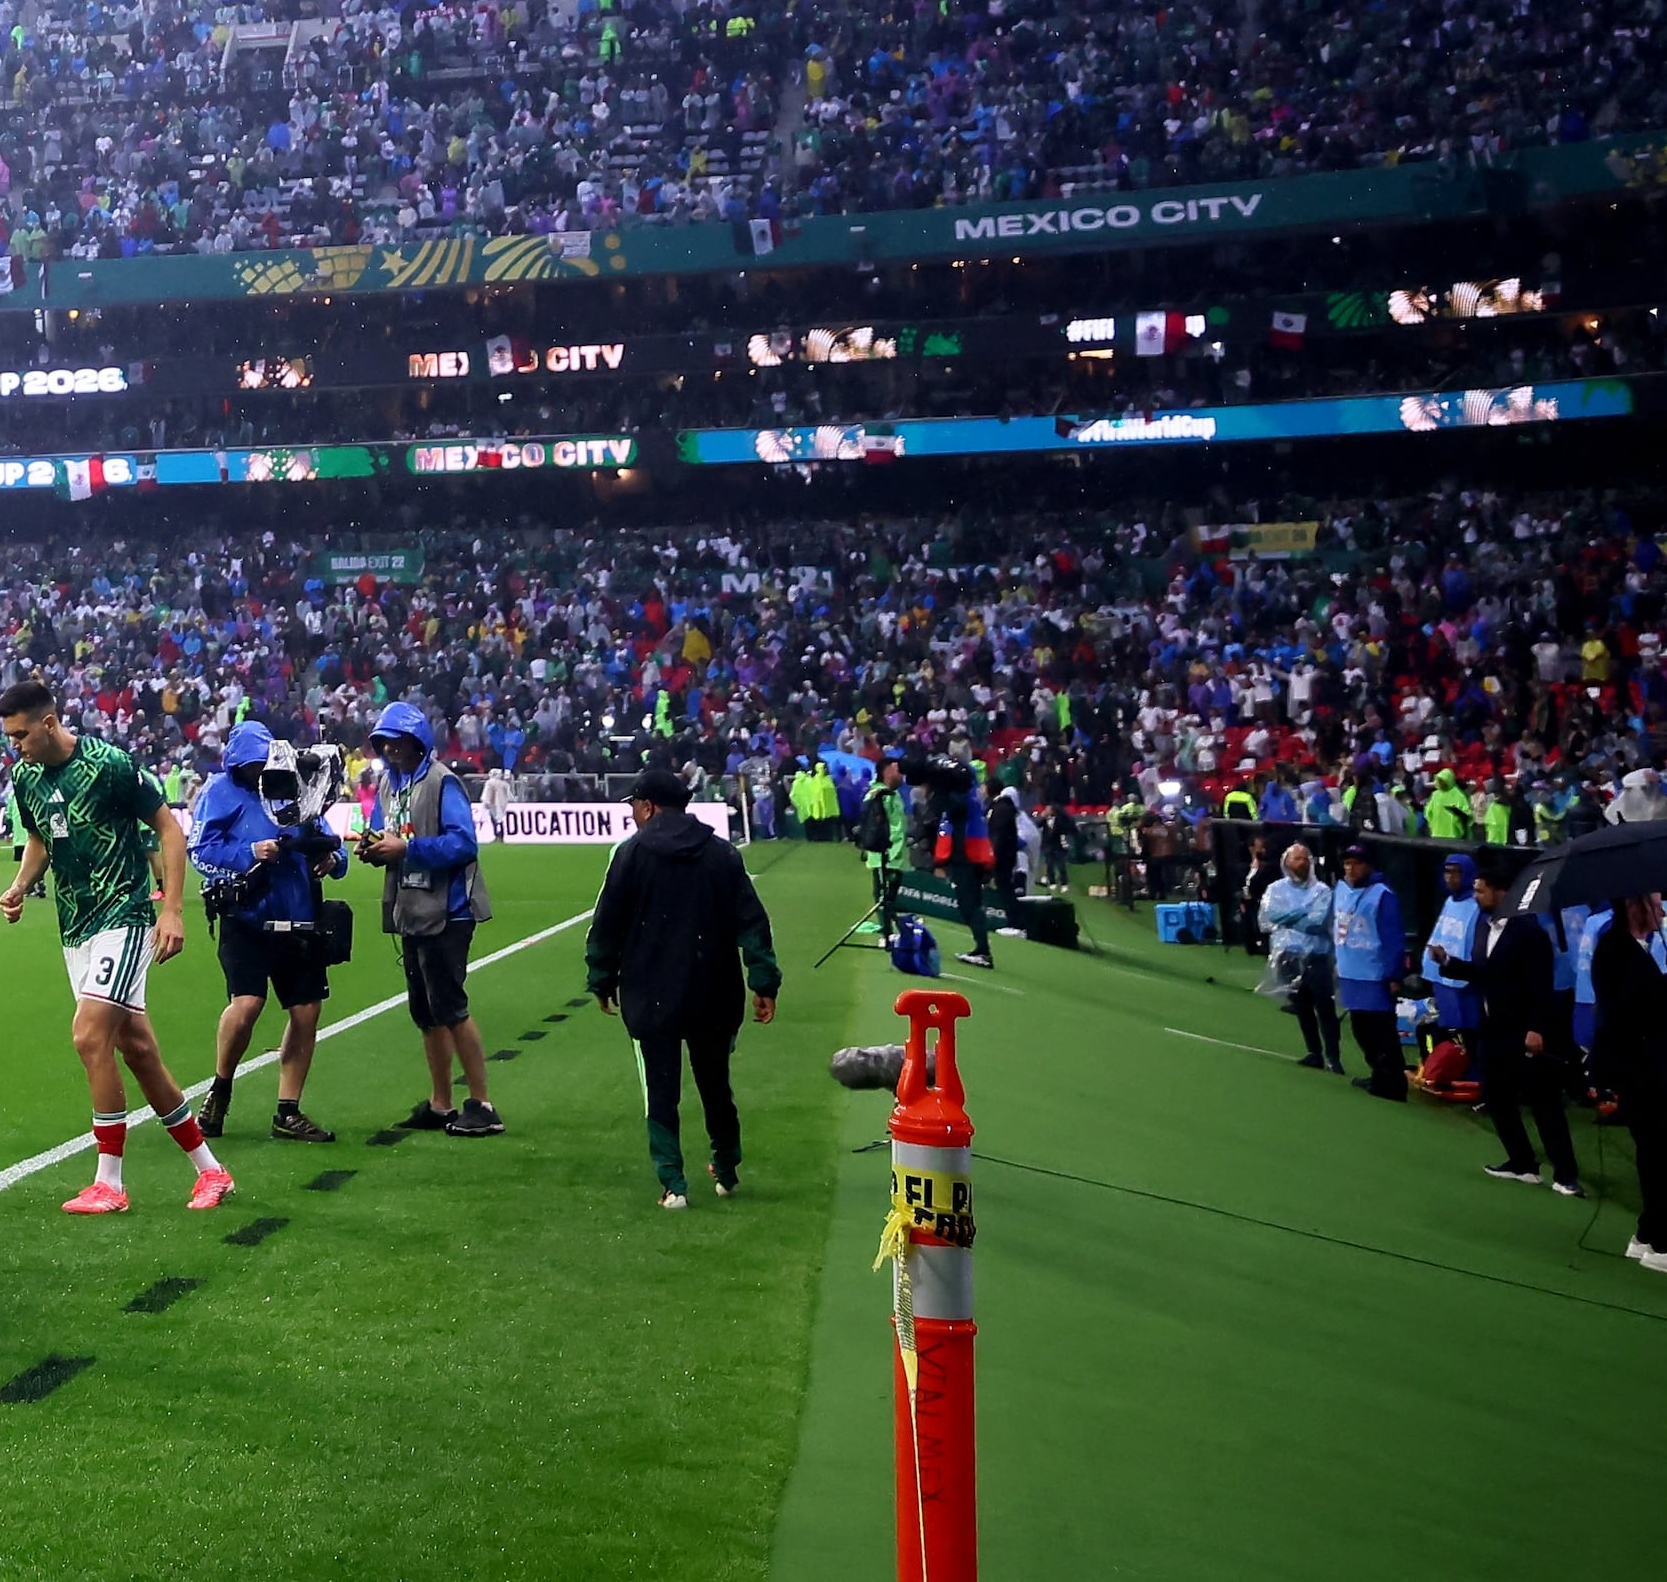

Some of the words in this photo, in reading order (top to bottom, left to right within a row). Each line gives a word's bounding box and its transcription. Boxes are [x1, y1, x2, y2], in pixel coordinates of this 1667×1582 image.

[955, 202, 1140, 241] MEXICO
[1150, 193, 1263, 223] CITY
[546, 344, 625, 371] CITY
[23, 367, 124, 395] 2026
[414, 442, 545, 471] MEXCO
[553, 439, 632, 467] CITY
[27, 458, 131, 486] 26
[503, 810, 612, 836] DUCATION
[897, 885, 921, 899] FIFA
[921, 892, 960, 909] WORL
[95, 956, 115, 985] 3
